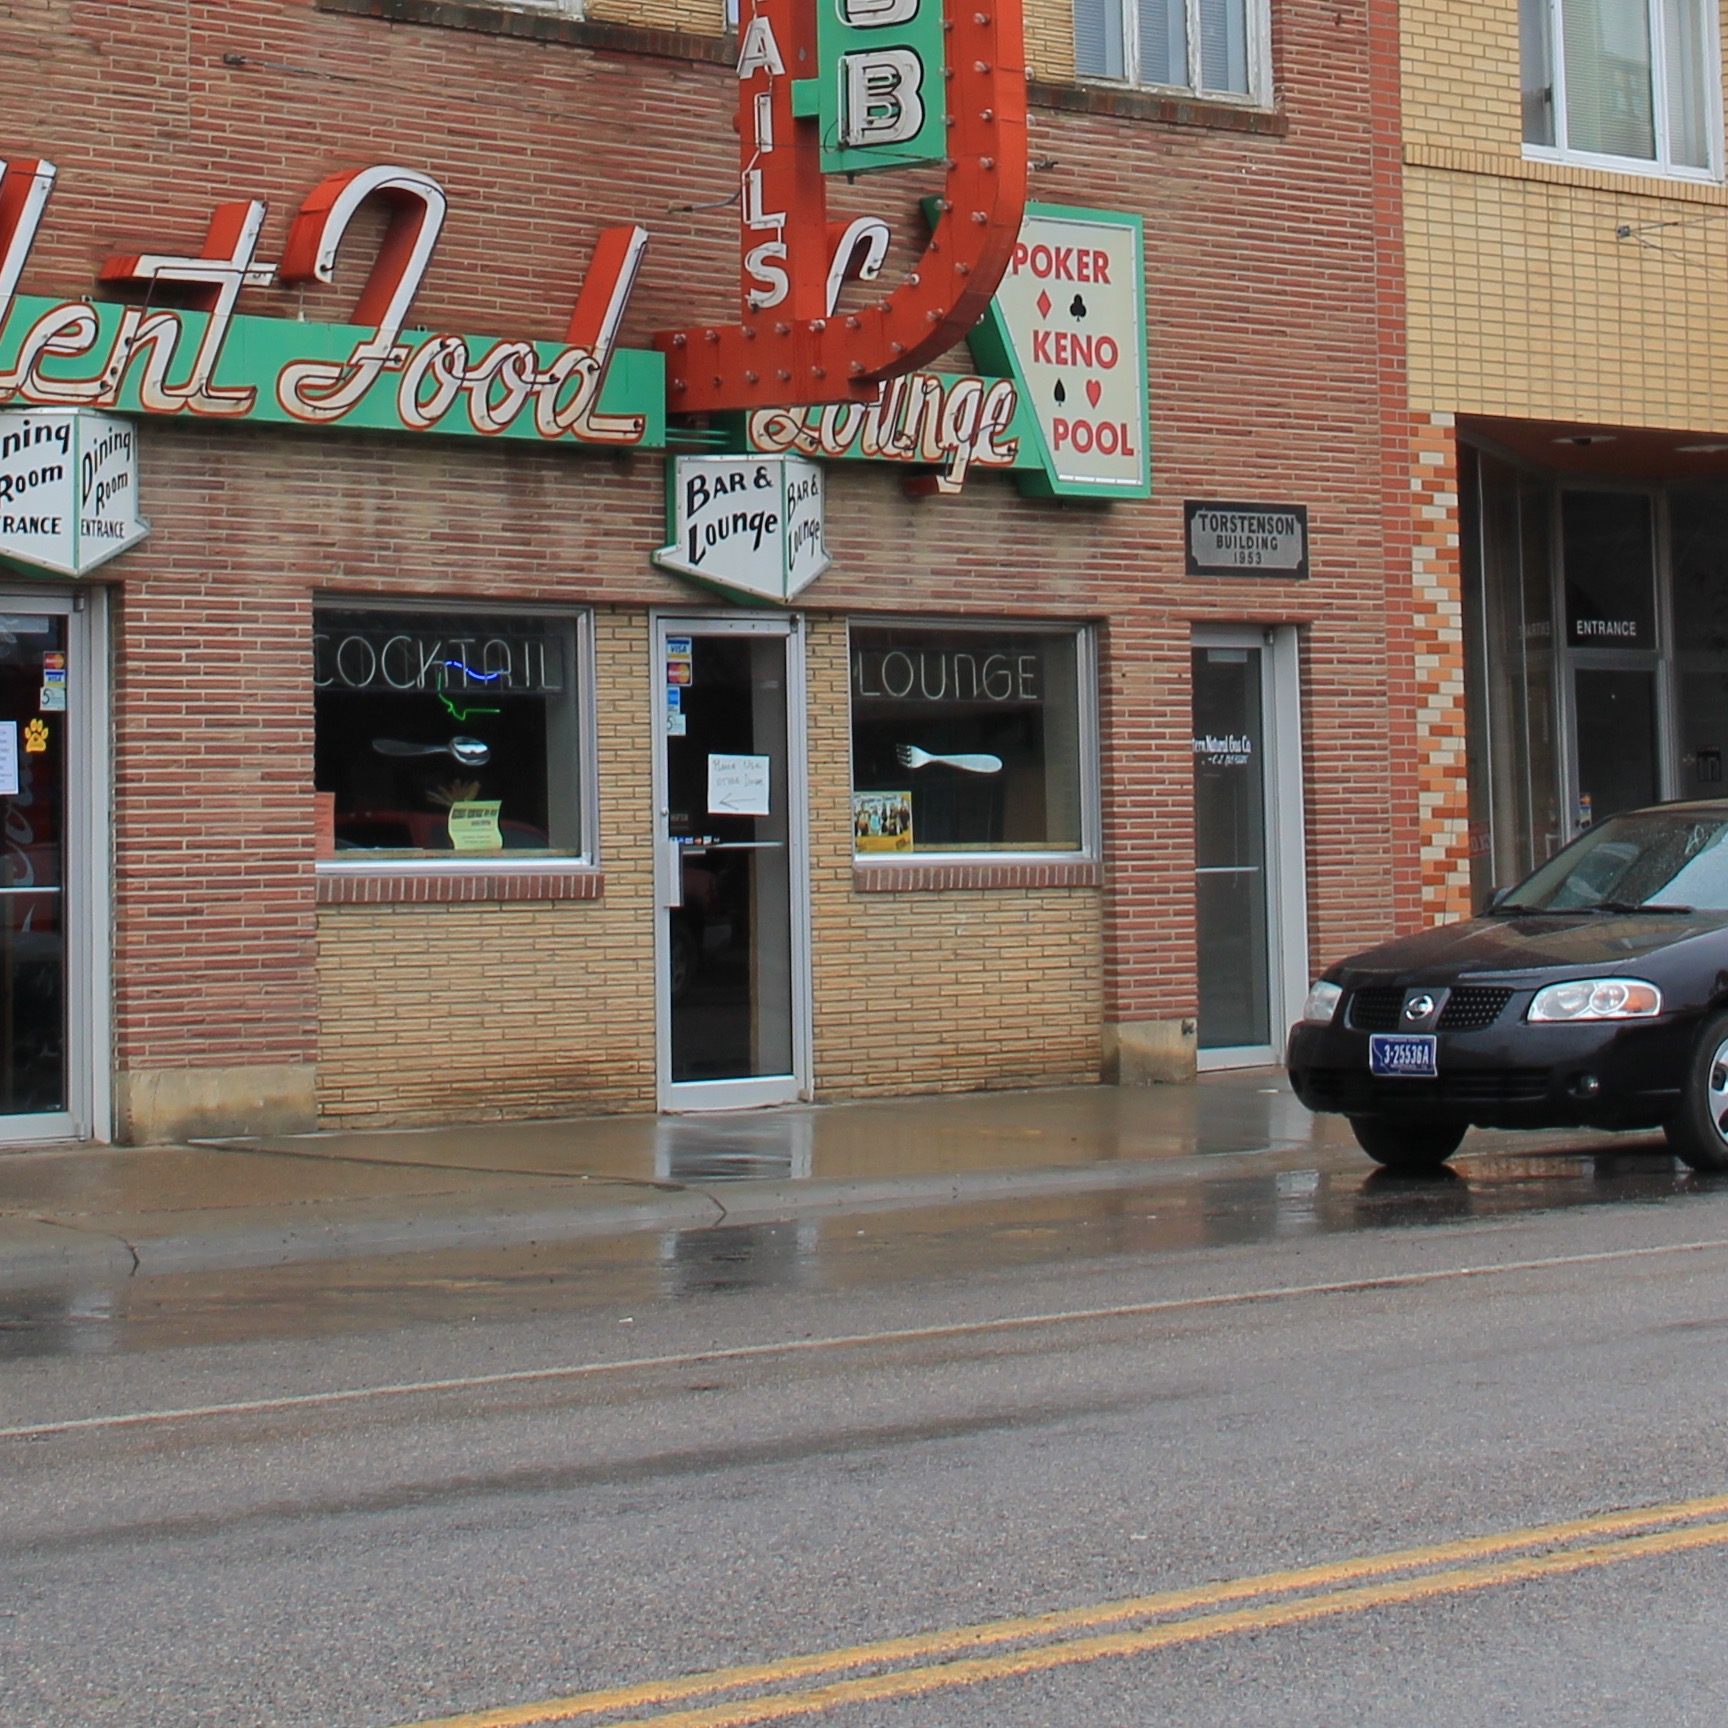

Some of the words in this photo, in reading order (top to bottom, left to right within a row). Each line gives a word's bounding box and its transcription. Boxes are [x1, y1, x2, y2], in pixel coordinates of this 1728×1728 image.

[1011, 242, 1112, 285] POKER
[274, 162, 649, 444] Food
[1032, 329, 1119, 370] KENO
[1052, 417, 1135, 456] POOL
[82, 426, 132, 510] Dining
[95, 472, 129, 517] Room
[687, 474, 747, 520] BAR
[753, 466, 774, 490] &
[787, 480, 810, 524] BAR
[80, 518, 126, 540] ENTRANCE
[688, 511, 779, 566] Lounge
[788, 518, 820, 572] Lounge
[1199, 513, 1296, 537] TORSTENSON
[1216, 535, 1279, 553] BUILDING
[1233, 551, 1263, 566] 1953
[1577, 619, 1637, 637] ENTRANCE
[313, 635, 562, 690] COCKTAIL
[858, 651, 1038, 701] LOUNGE
